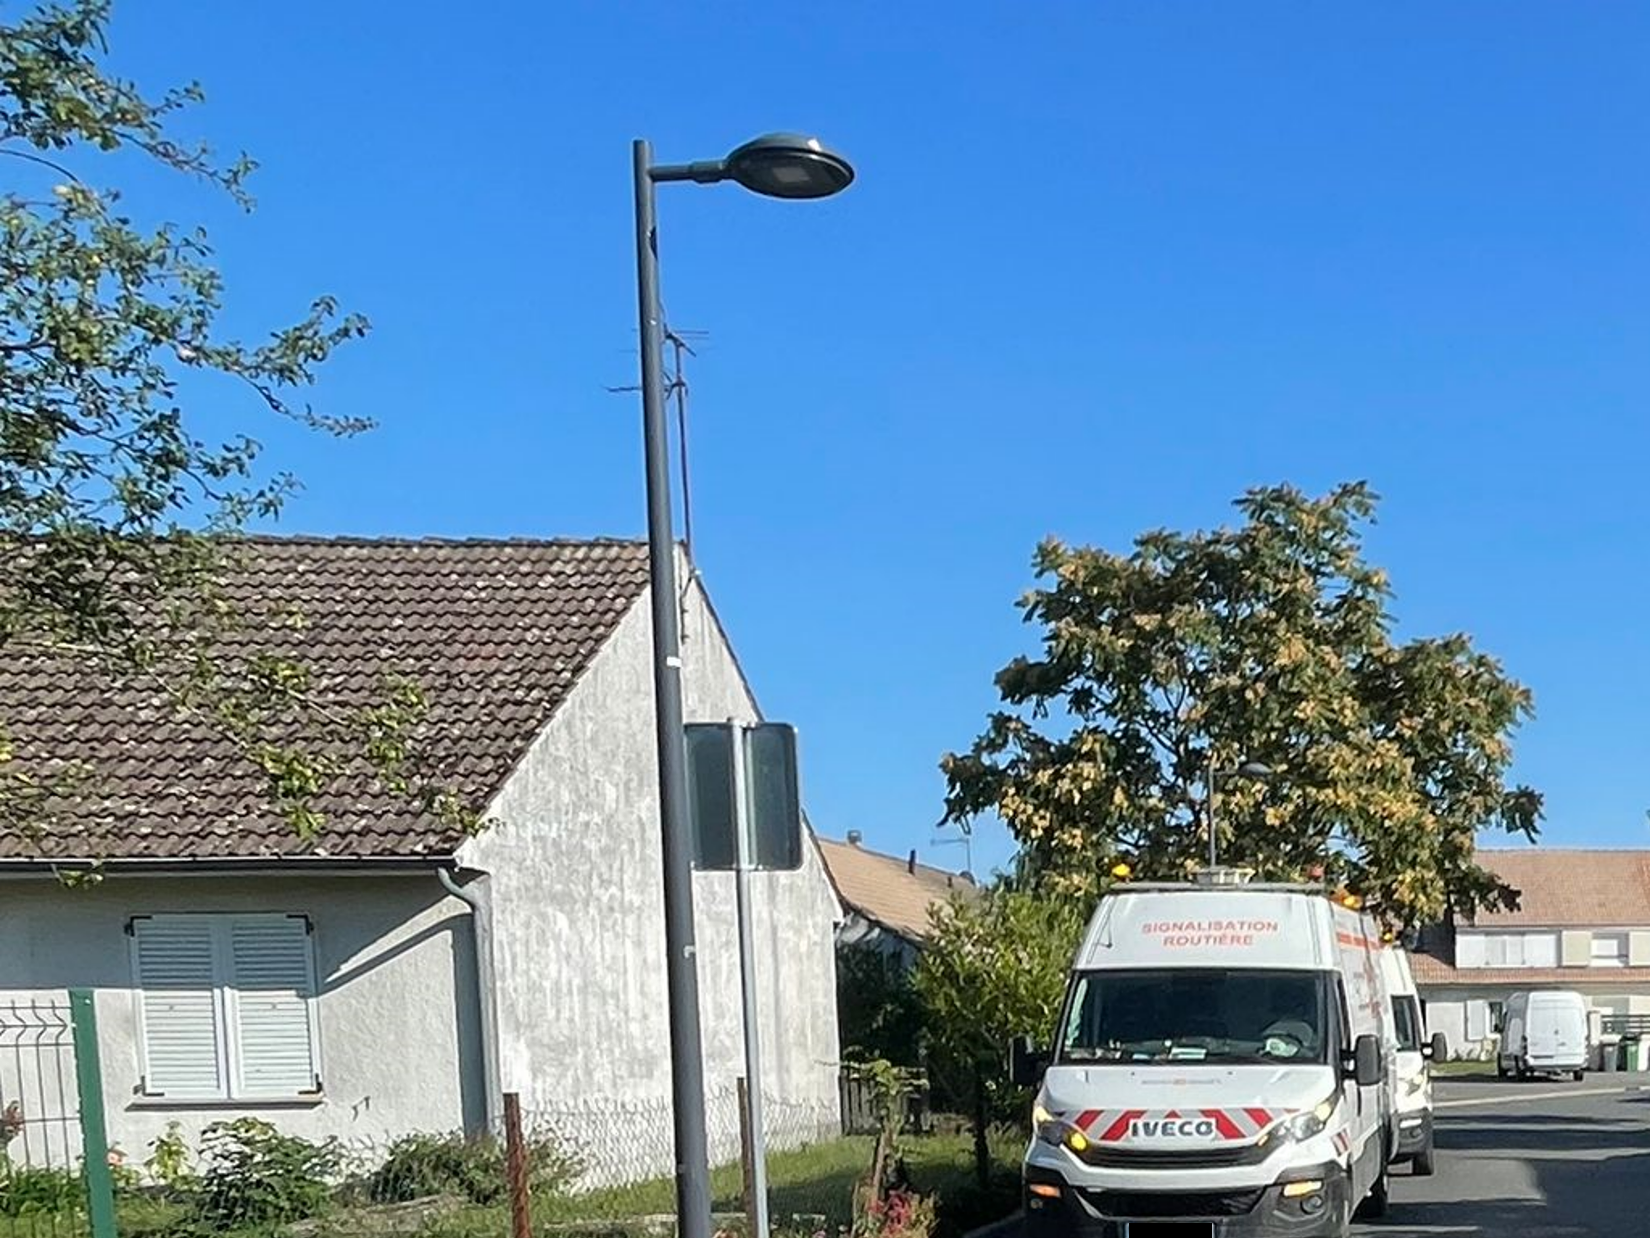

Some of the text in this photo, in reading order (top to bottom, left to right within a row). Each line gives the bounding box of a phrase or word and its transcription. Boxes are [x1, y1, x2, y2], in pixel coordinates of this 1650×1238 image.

[1142, 920, 1279, 934] SIGNALISATION
[1162, 932, 1254, 946] ROUTIÈRE
[1131, 1120, 1214, 1137] IVECO
